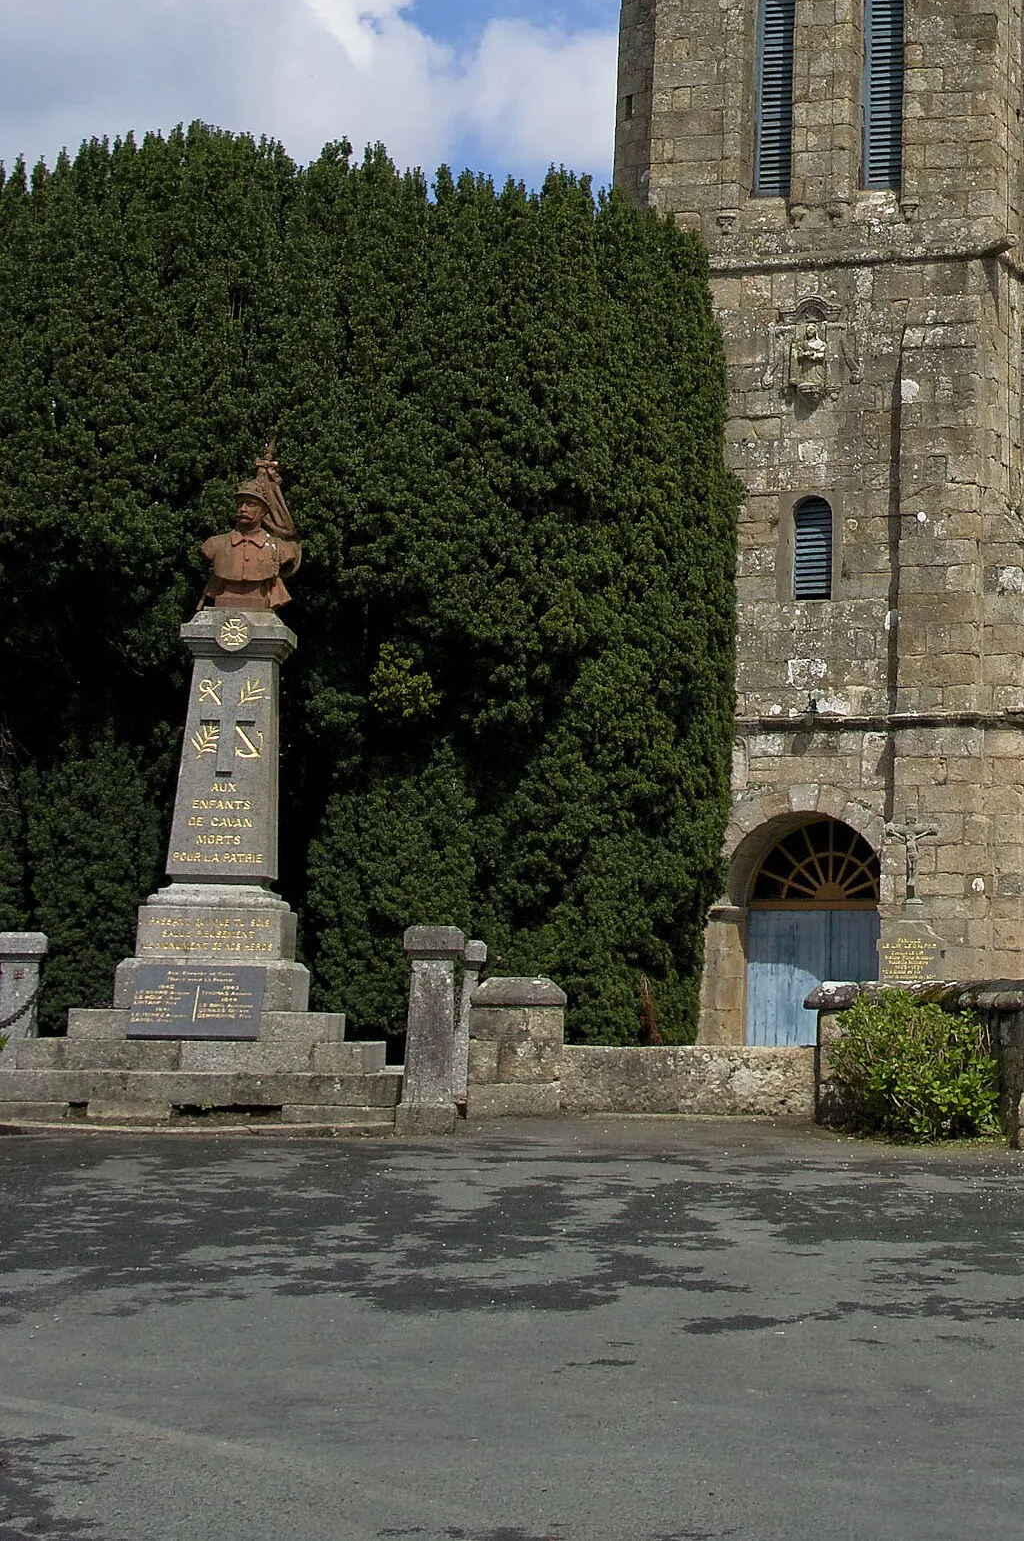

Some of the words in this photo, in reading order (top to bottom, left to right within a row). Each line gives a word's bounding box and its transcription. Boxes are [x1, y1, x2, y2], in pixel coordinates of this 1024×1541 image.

[210, 782, 237, 793] AUX
[192, 799, 251, 810] ENFANTS
[188, 816, 204, 827] DE
[210, 817, 253, 828] CAVAN
[195, 834, 241, 845] MORTS
[173, 851, 201, 862] POUR
[204, 852, 219, 863] LA
[222, 852, 263, 863] PATRIE
